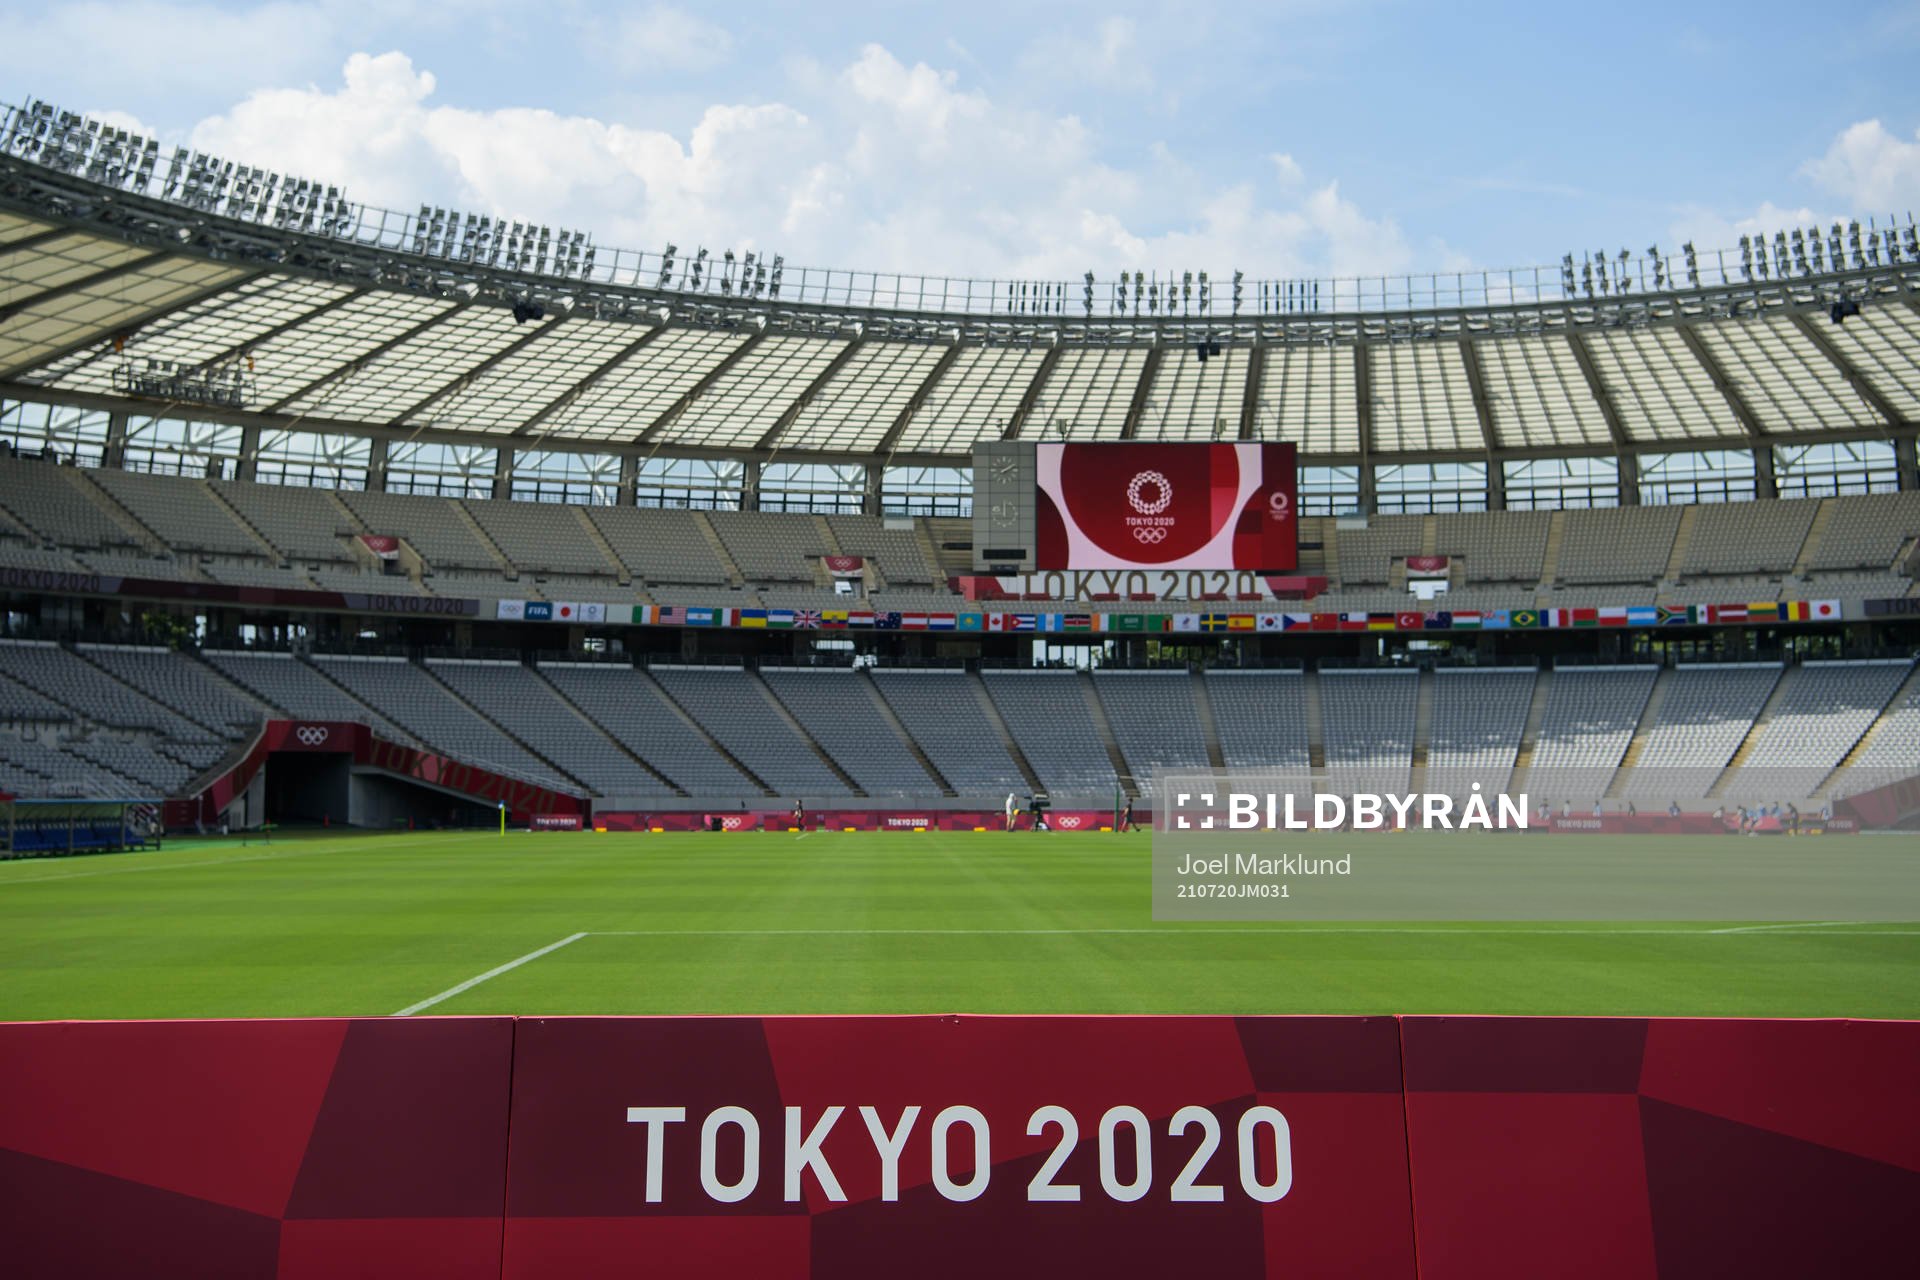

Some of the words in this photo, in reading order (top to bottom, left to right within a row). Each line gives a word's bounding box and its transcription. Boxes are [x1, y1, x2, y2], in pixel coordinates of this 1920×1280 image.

[1126, 517, 1152, 526] TOKYO
[1154, 517, 1175, 526] 2020
[1018, 570, 1147, 600] TOKYO
[1160, 570, 1256, 600] 2020
[366, 595, 420, 613] TOKYO
[424, 597, 464, 615] 2020
[528, 606, 548, 616] FIFA
[627, 1105, 990, 1203] TOKYO
[1026, 1105, 1293, 1203] 2020
